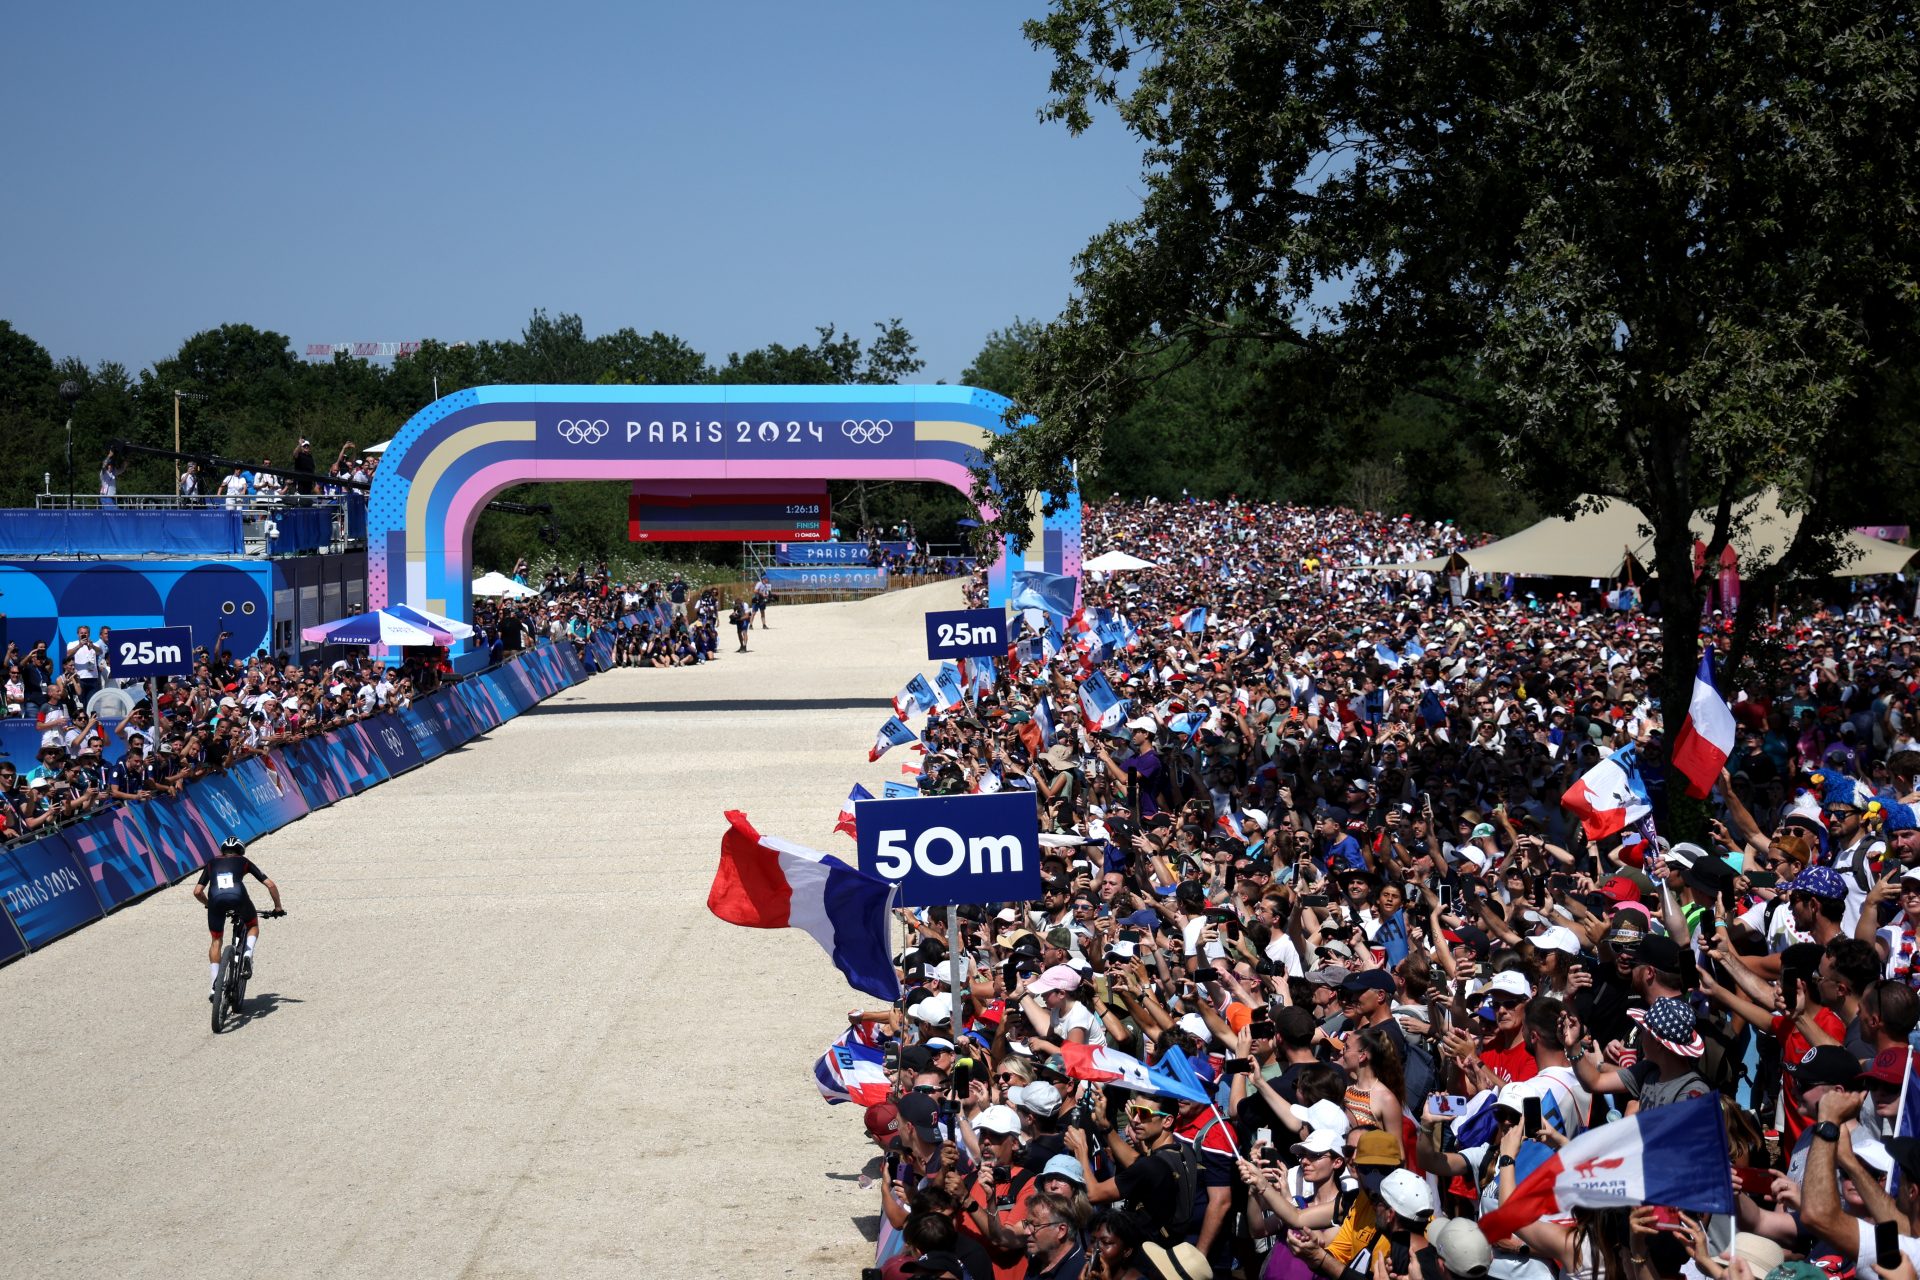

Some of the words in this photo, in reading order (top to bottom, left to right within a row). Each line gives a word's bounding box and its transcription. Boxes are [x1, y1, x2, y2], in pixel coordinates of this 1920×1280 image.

[736, 421, 823, 443] 2024
[786, 505, 820, 514] 1:26:18
[851, 548, 869, 558] 20
[937, 622, 997, 647] 25m
[120, 641, 182, 666] 25m
[875, 826, 1024, 879] 50m
[43, 866, 81, 898] 2024
